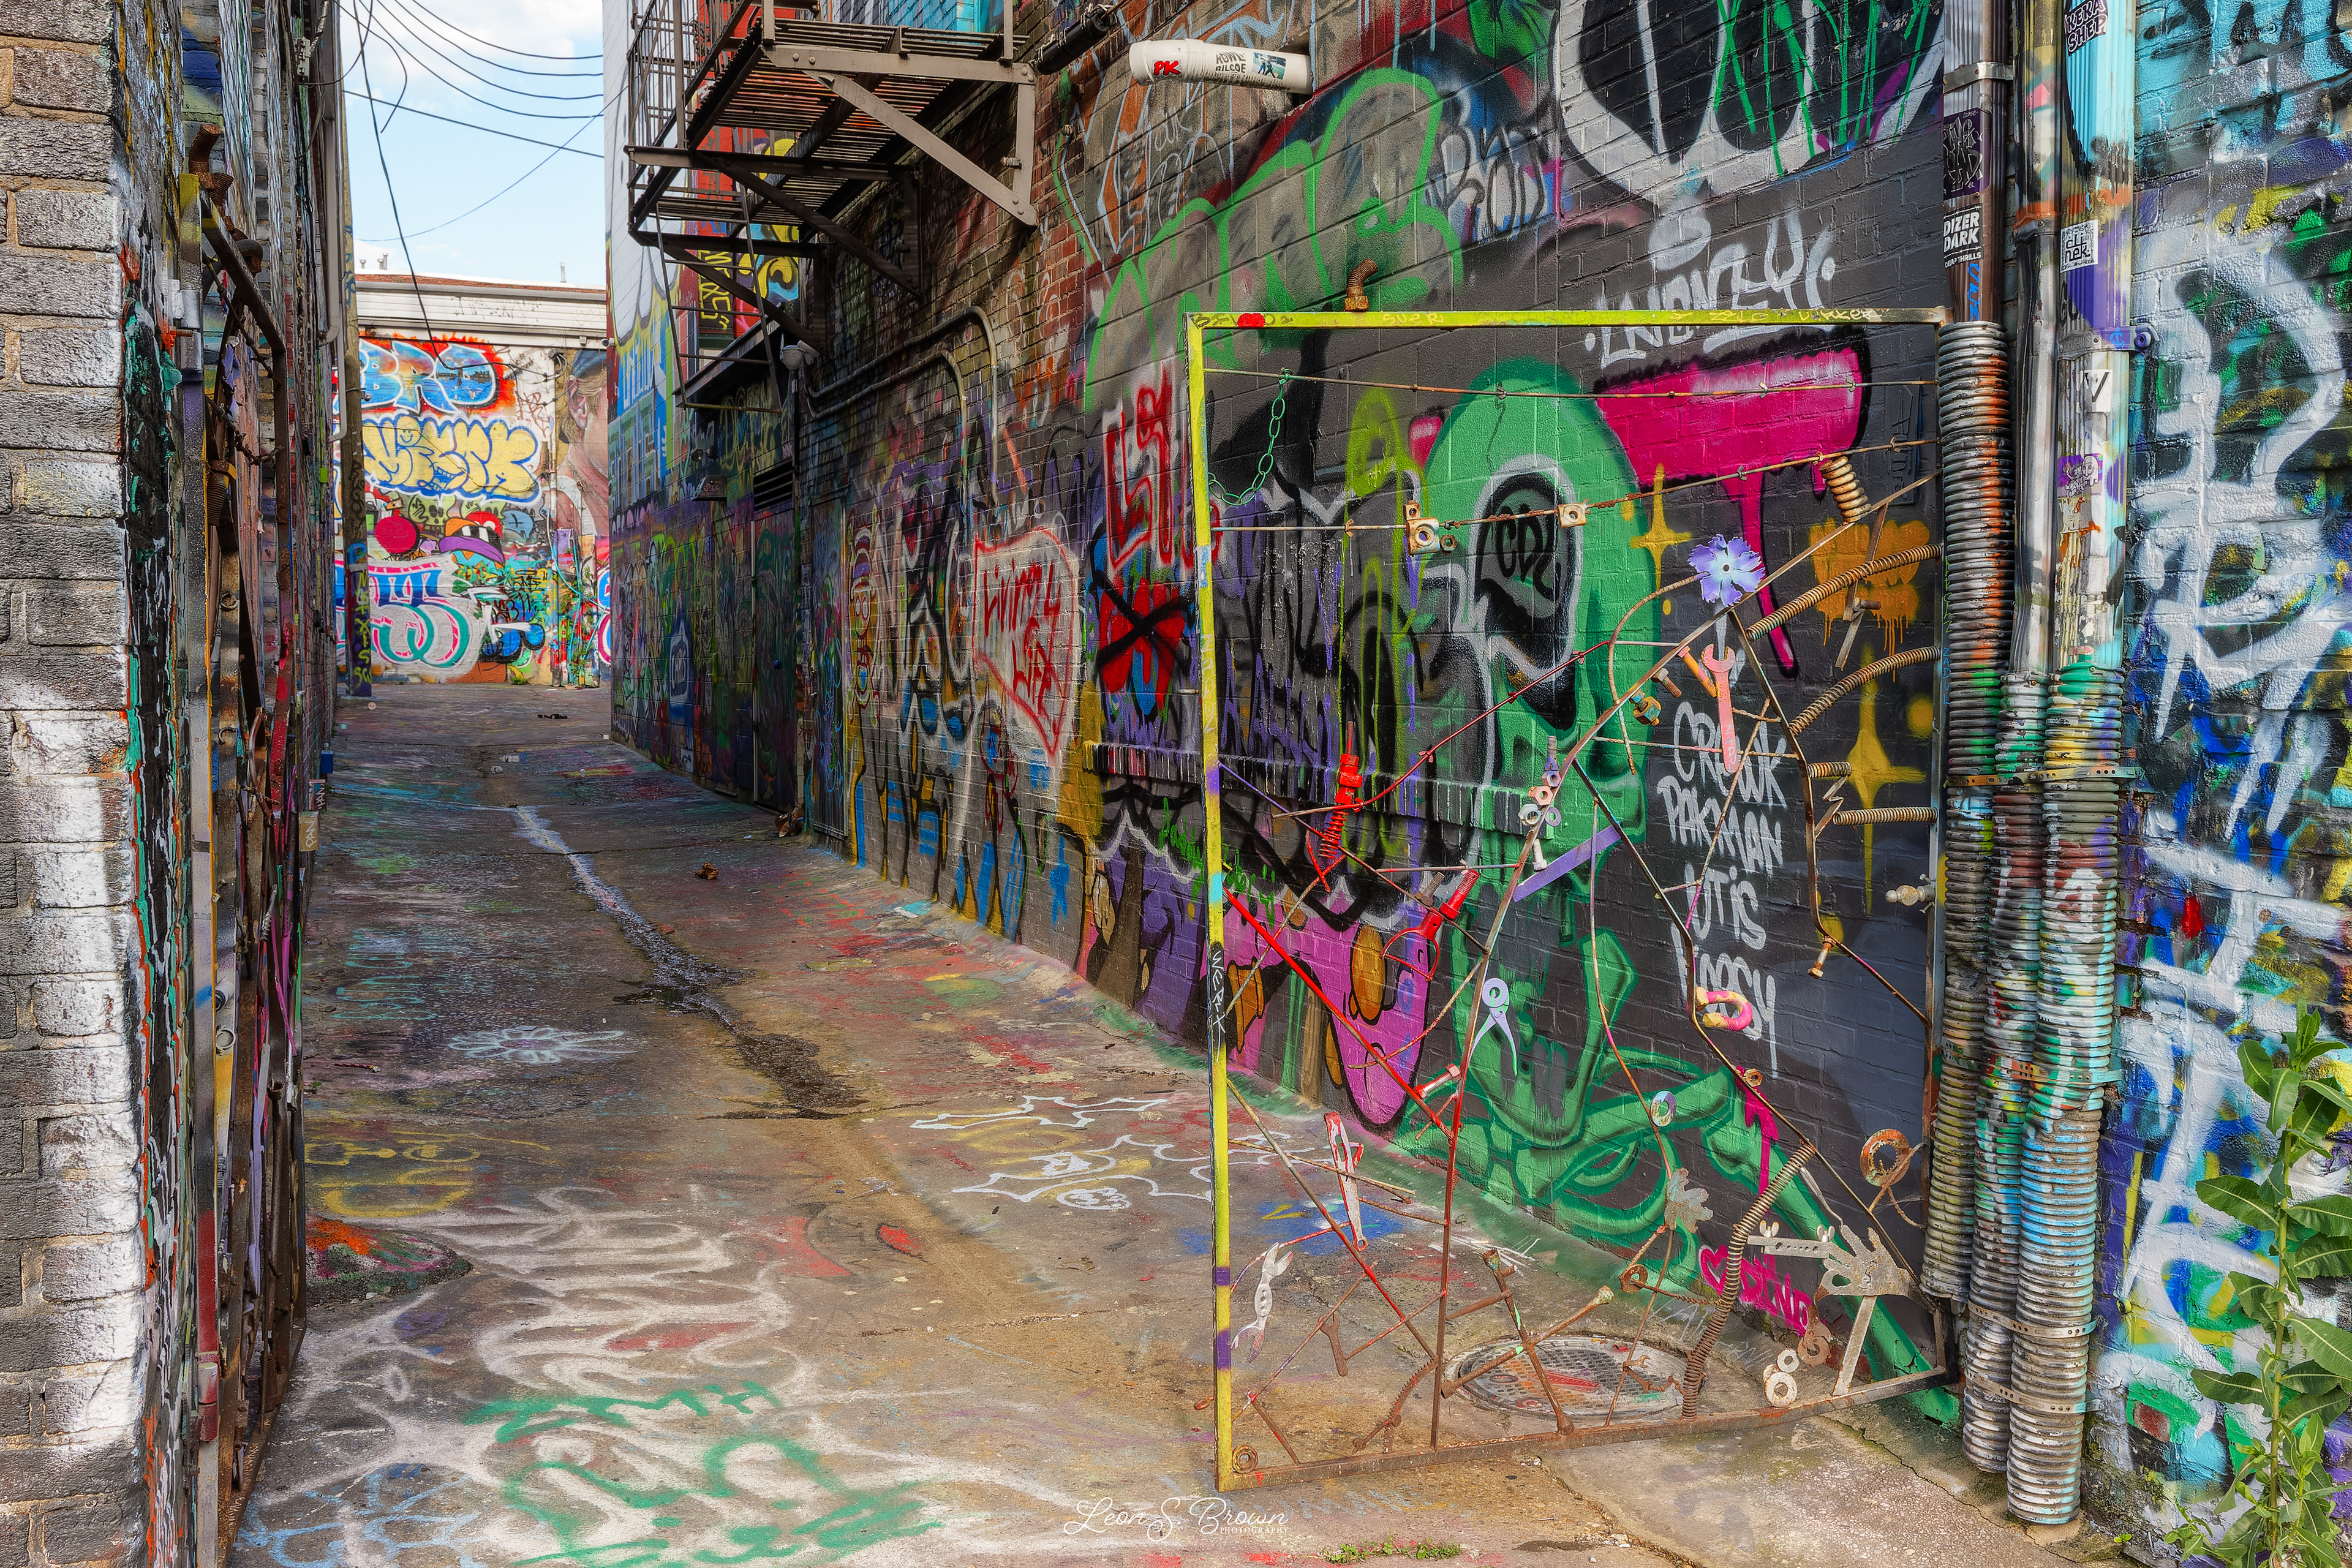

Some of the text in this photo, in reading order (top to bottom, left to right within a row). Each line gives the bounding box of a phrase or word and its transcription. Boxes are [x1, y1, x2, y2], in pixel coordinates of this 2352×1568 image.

[1153, 60, 1181, 76] PK
[1943, 211, 1980, 237] DIZER
[1943, 227, 1980, 253] DARK
[1958, 252, 1981, 263] THRILLS
[1942, 647, 1951, 705] ZADUL
[1725, 725, 1737, 773] ZADUL
